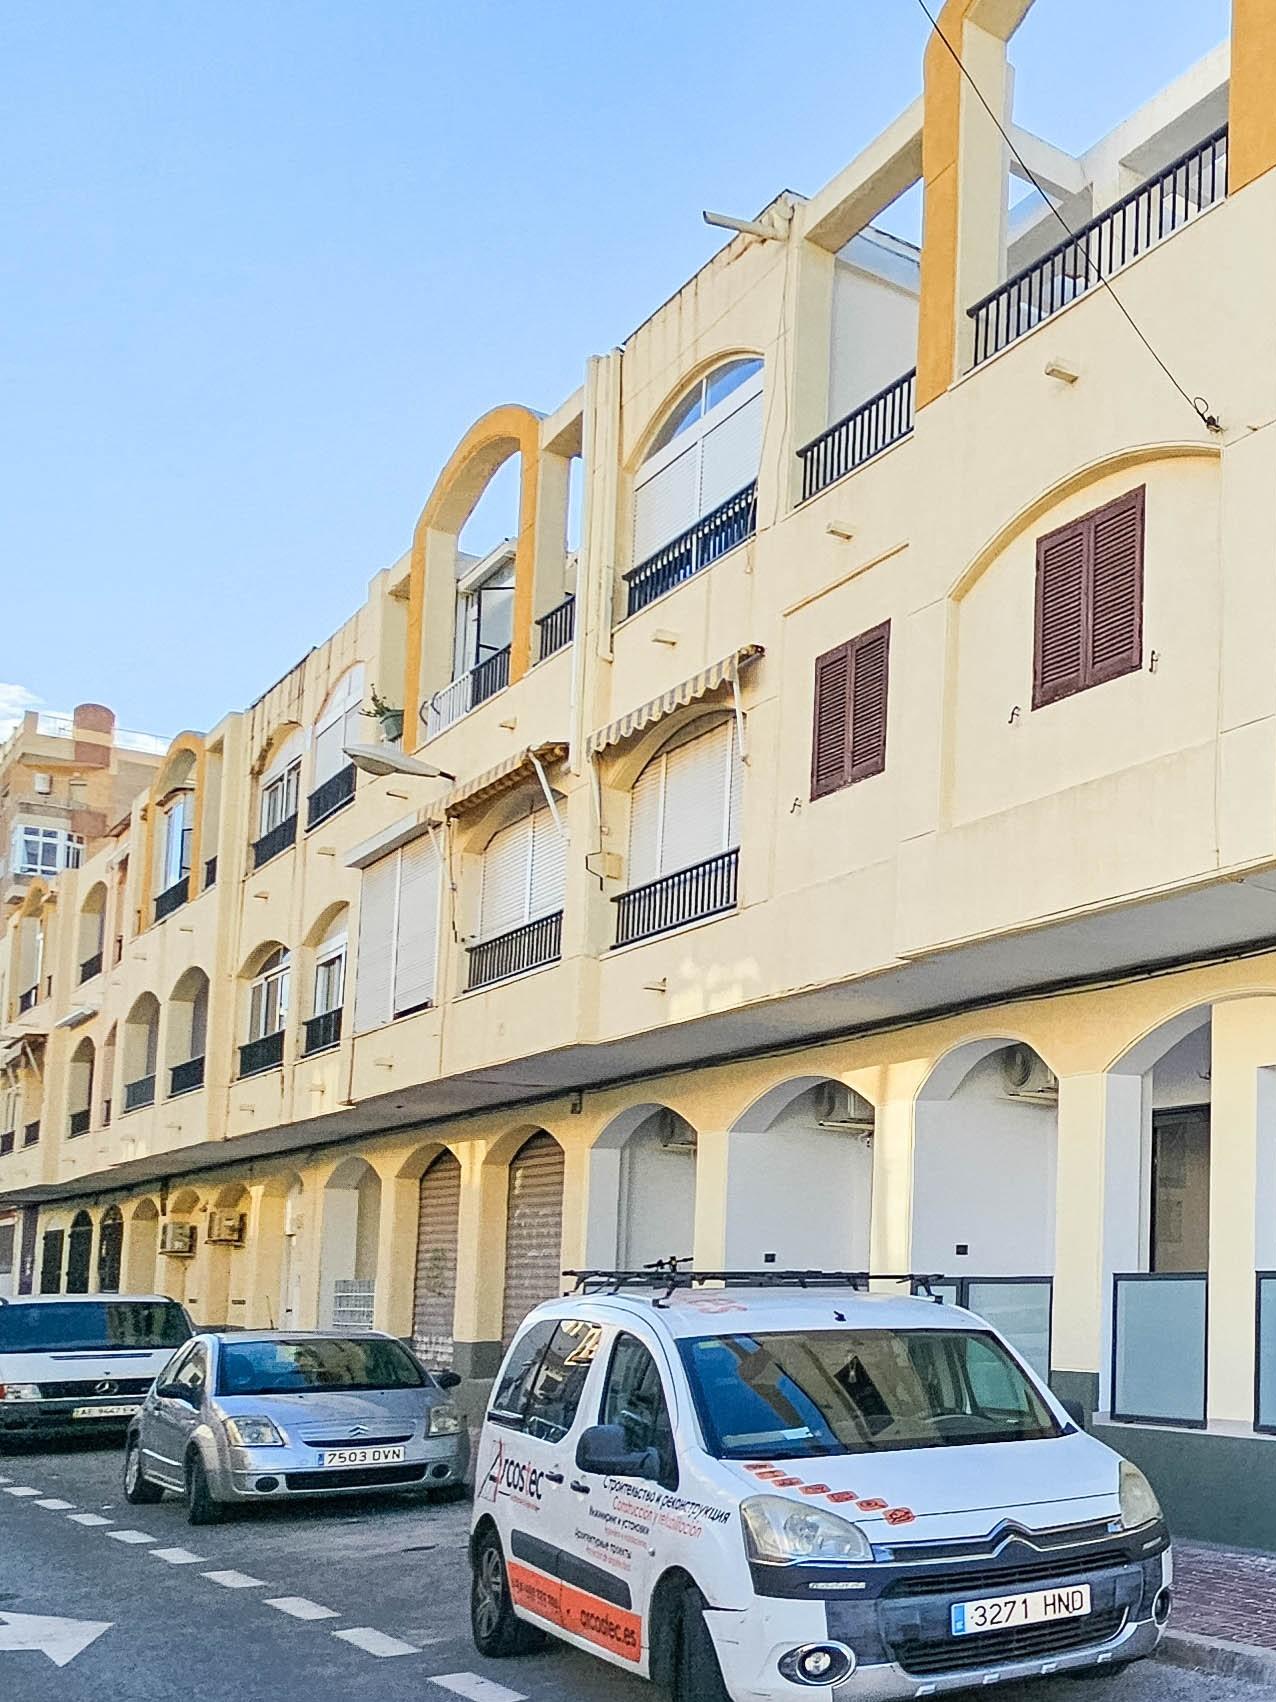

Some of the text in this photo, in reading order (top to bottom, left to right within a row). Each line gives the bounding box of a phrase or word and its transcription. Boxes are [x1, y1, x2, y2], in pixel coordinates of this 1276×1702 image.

[327, 1448, 401, 1465] 7503 DVN
[660, 1494, 731, 1525] реконструкция
[973, 1590, 1084, 1627] 3271 HND
[580, 1608, 637, 1648] arcostec.es
